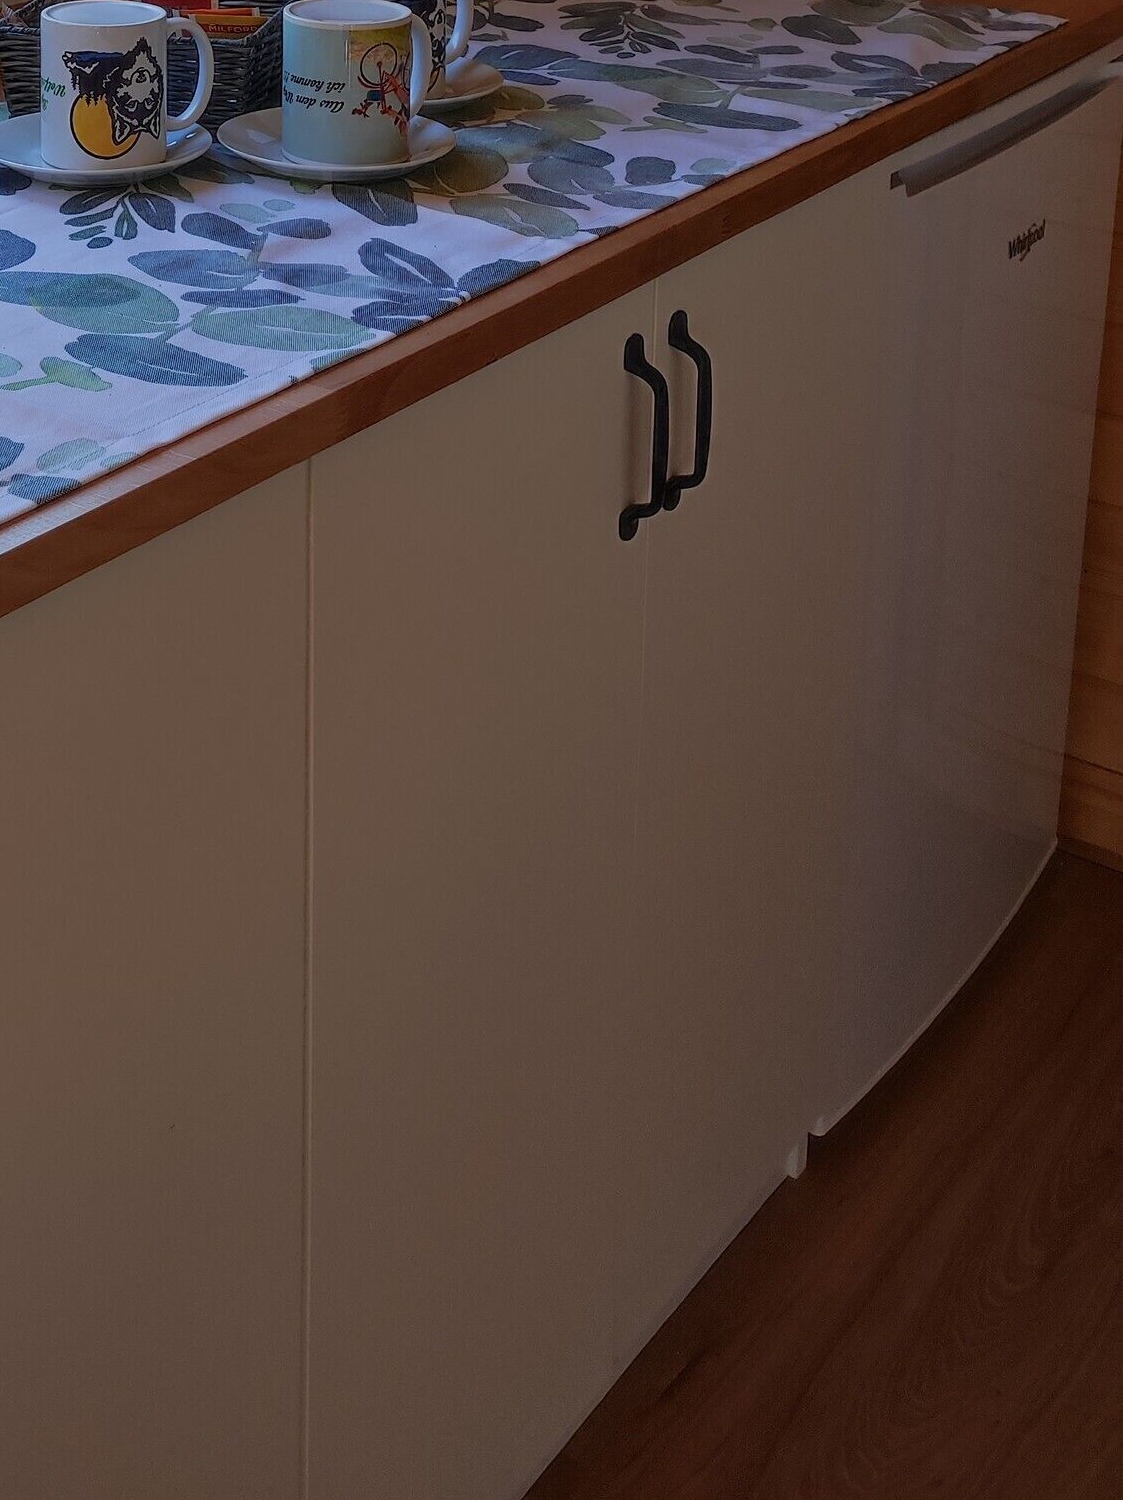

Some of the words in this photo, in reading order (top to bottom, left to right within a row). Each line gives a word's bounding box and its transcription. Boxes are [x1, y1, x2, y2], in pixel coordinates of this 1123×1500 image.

[325, 81, 346, 94] ich
[295, 94, 317, 109] dem
[319, 99, 345, 114] Aus
